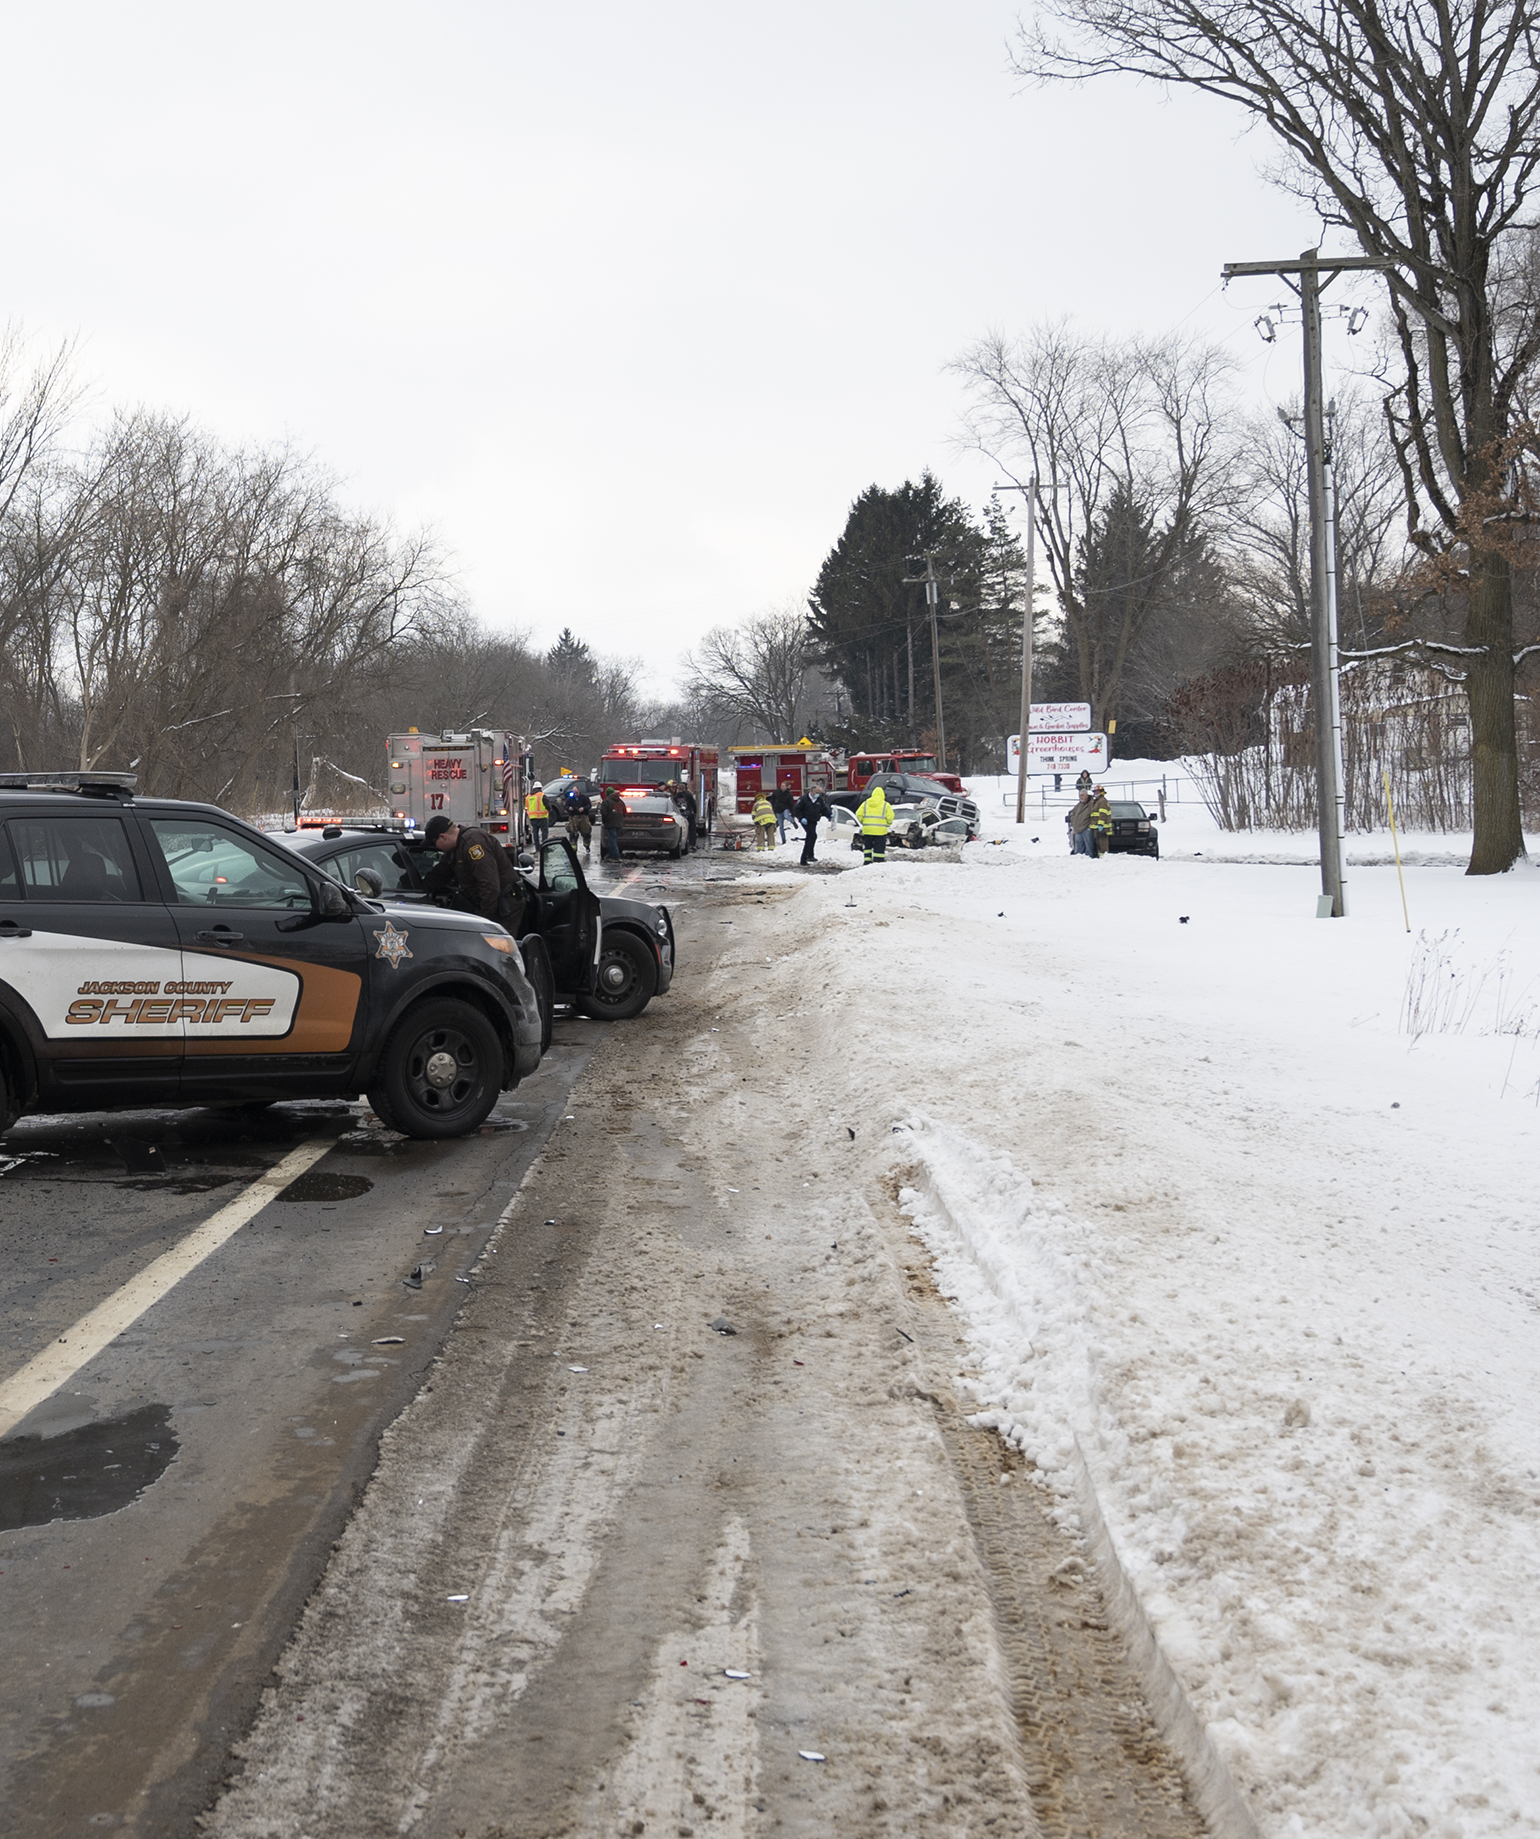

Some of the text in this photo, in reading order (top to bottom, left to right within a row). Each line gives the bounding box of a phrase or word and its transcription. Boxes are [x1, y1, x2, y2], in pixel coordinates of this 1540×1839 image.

[1036, 736, 1074, 744] HOBBIT
[1027, 743, 1084, 754] Greenhouses
[433, 759, 462, 769] HEAVY
[431, 770, 467, 779] RESCUE
[430, 794, 444, 810] 17
[77, 981, 233, 994] JACKSON COUNTY
[65, 999, 276, 1024] SHERIFF
